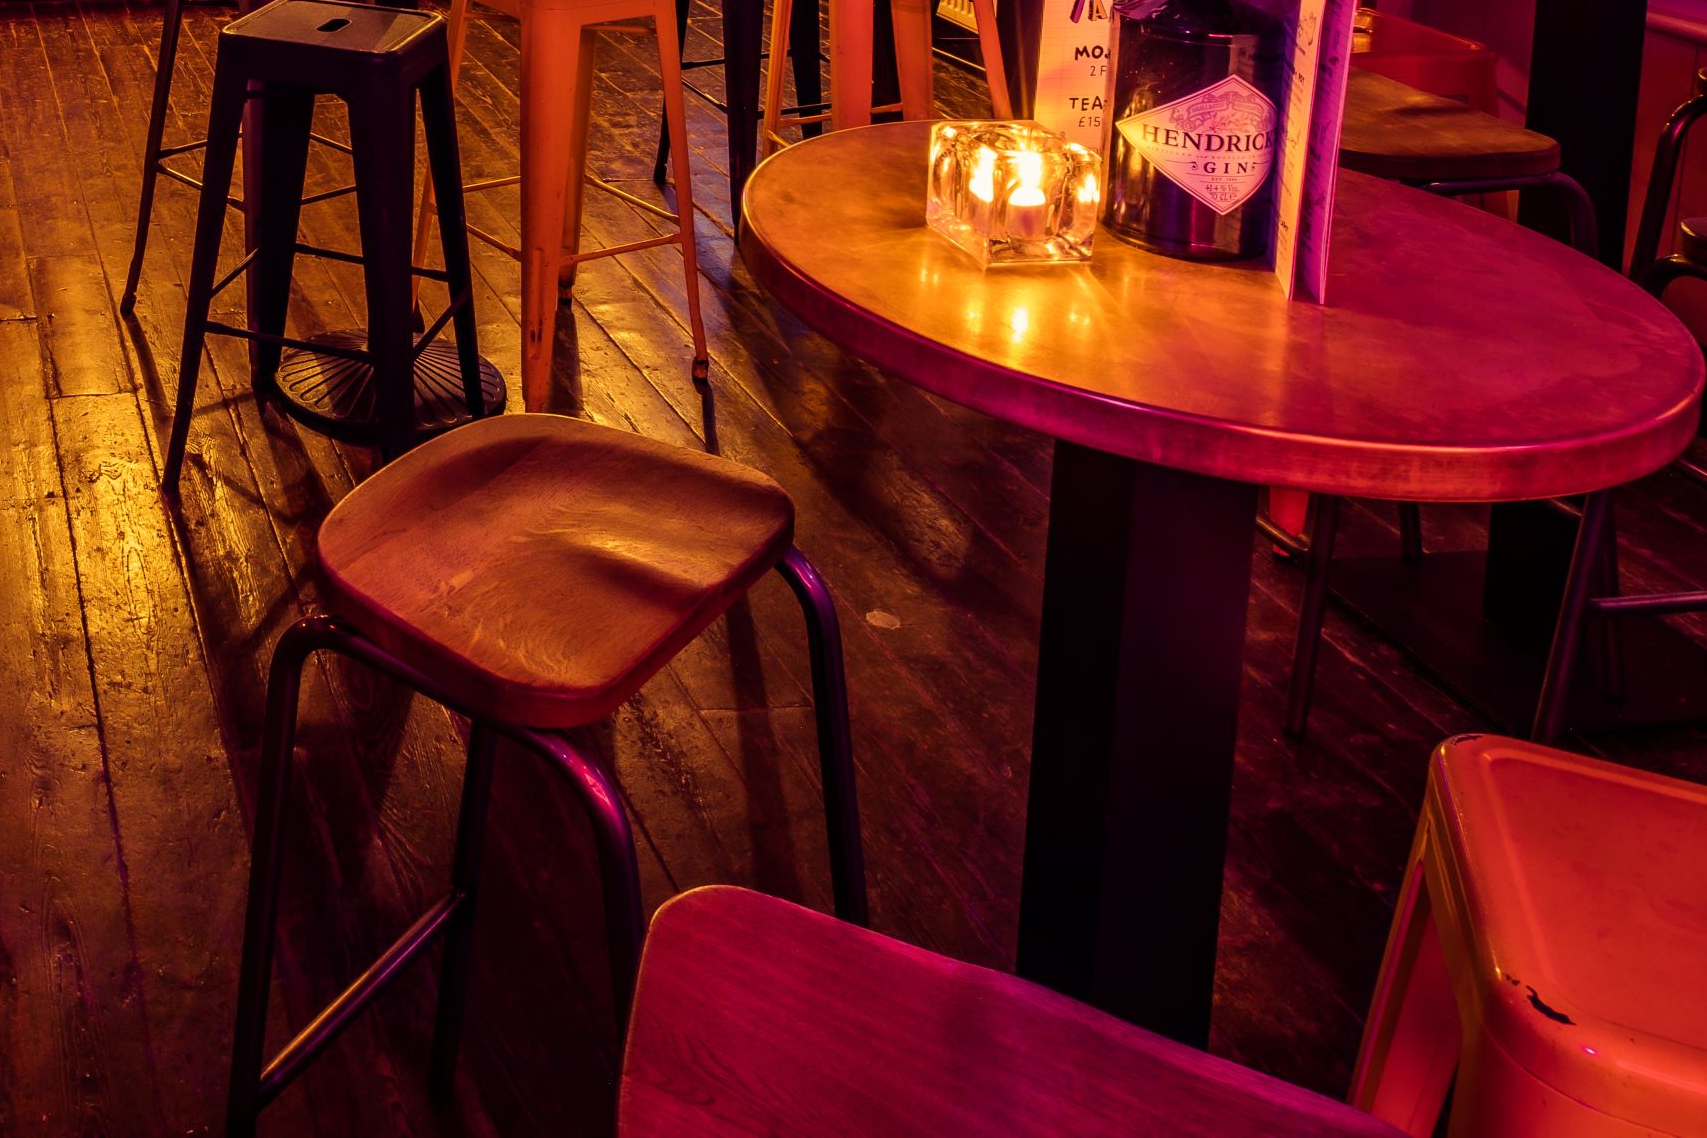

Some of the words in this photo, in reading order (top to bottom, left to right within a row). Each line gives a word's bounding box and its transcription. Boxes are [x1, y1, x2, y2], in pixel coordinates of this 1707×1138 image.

[1090, 66, 1096, 76] 2
[1069, 96, 1108, 111] TEA
[1078, 116, 1101, 128] £15
[1204, 162, 1248, 174] GIN
